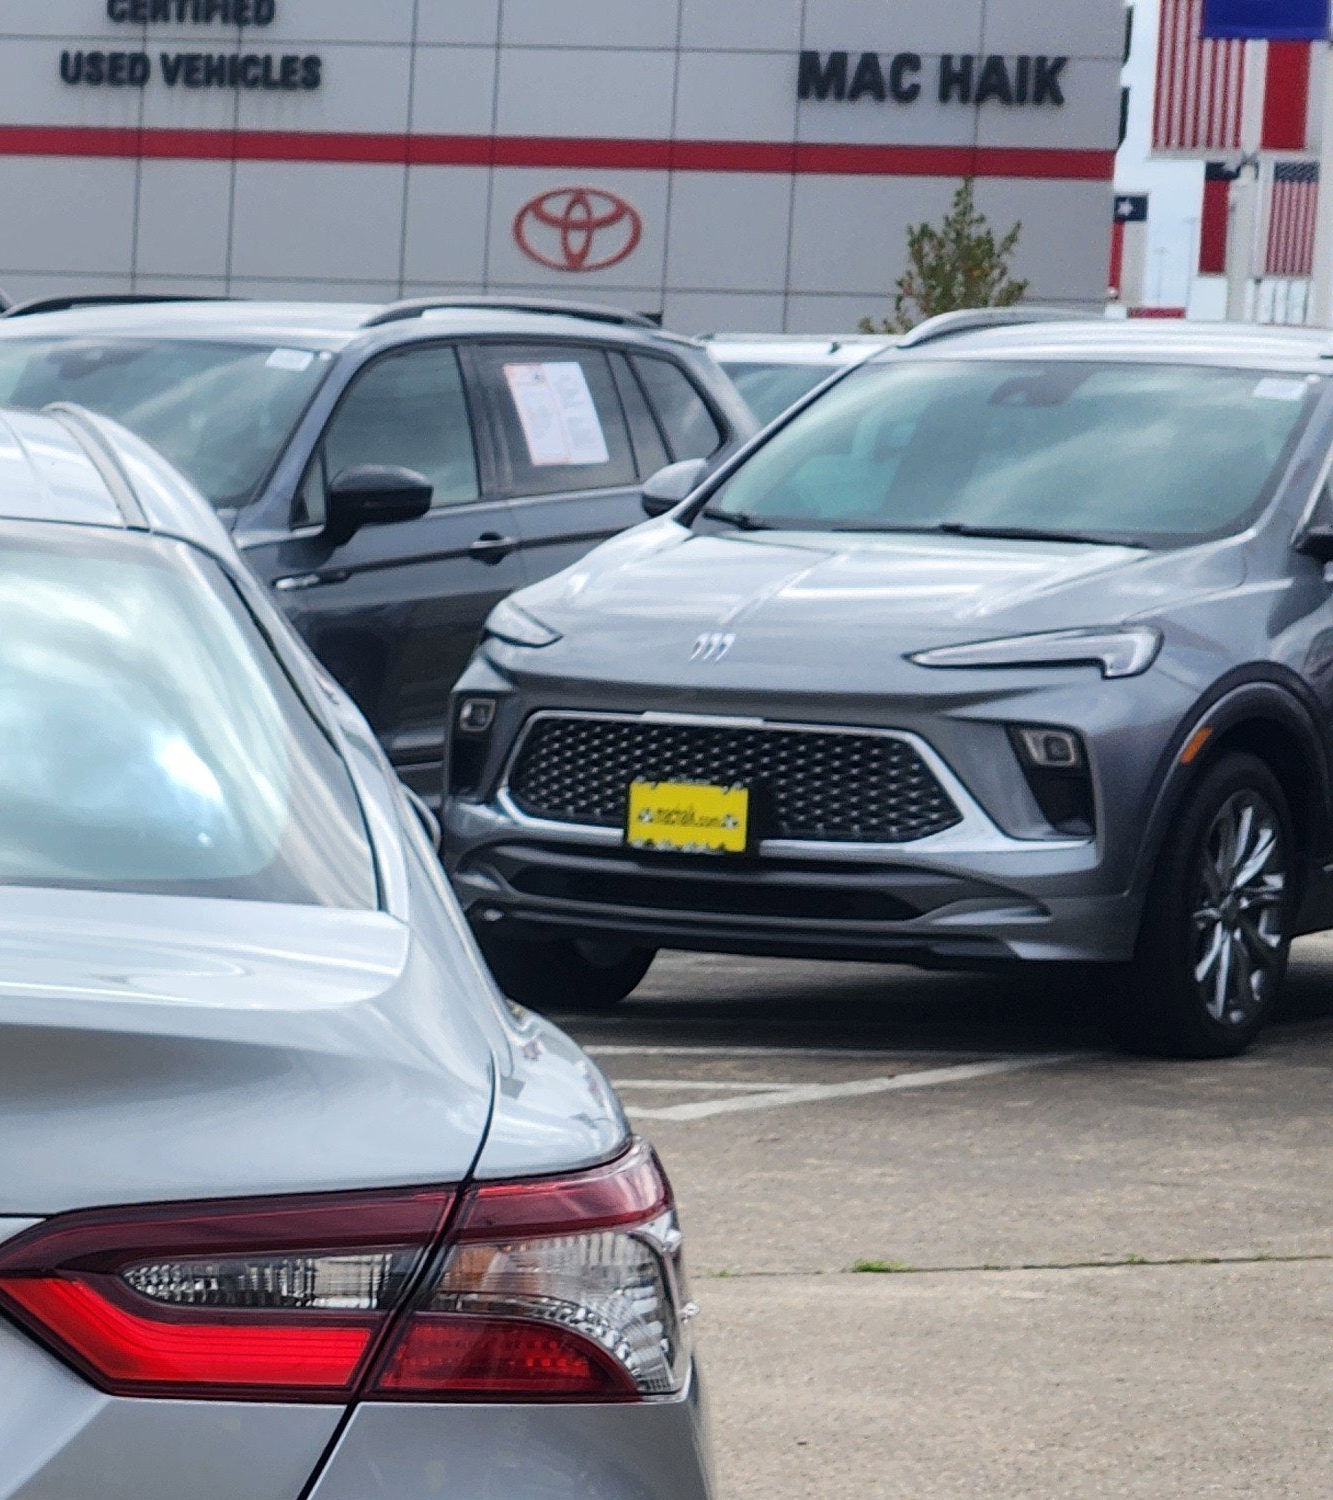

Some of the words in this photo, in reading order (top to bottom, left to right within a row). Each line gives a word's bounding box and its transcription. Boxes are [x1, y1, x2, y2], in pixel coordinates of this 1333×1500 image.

[59, 50, 151, 85] USED
[159, 53, 323, 89] VEHICLES
[797, 50, 921, 103] MAC
[939, 54, 1068, 105] HAIK
